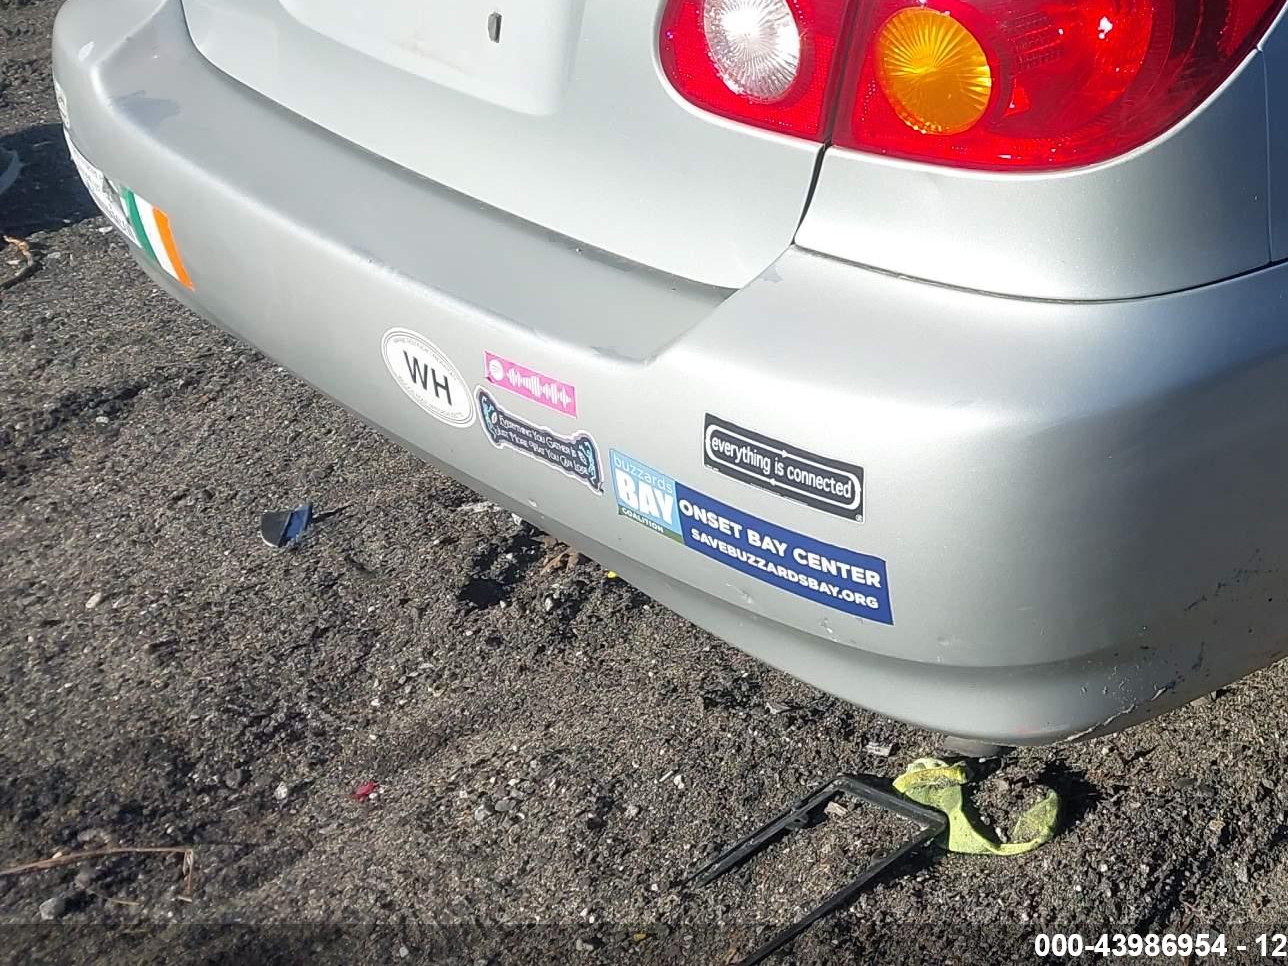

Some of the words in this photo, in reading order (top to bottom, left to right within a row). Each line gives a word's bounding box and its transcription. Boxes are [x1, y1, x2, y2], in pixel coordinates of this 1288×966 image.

[403, 349, 452, 407] WH
[614, 454, 673, 494] buzzards
[616, 468, 674, 525] BAY
[711, 436, 771, 475] everything
[774, 457, 785, 476] is
[786, 465, 852, 499] connected
[621, 508, 664, 534] COALITION
[679, 499, 743, 539] ONSET
[746, 528, 787, 558] BAY
[793, 547, 881, 588] CENTER
[691, 527, 879, 609] SAVEBUZZARDSBAY.ORG
